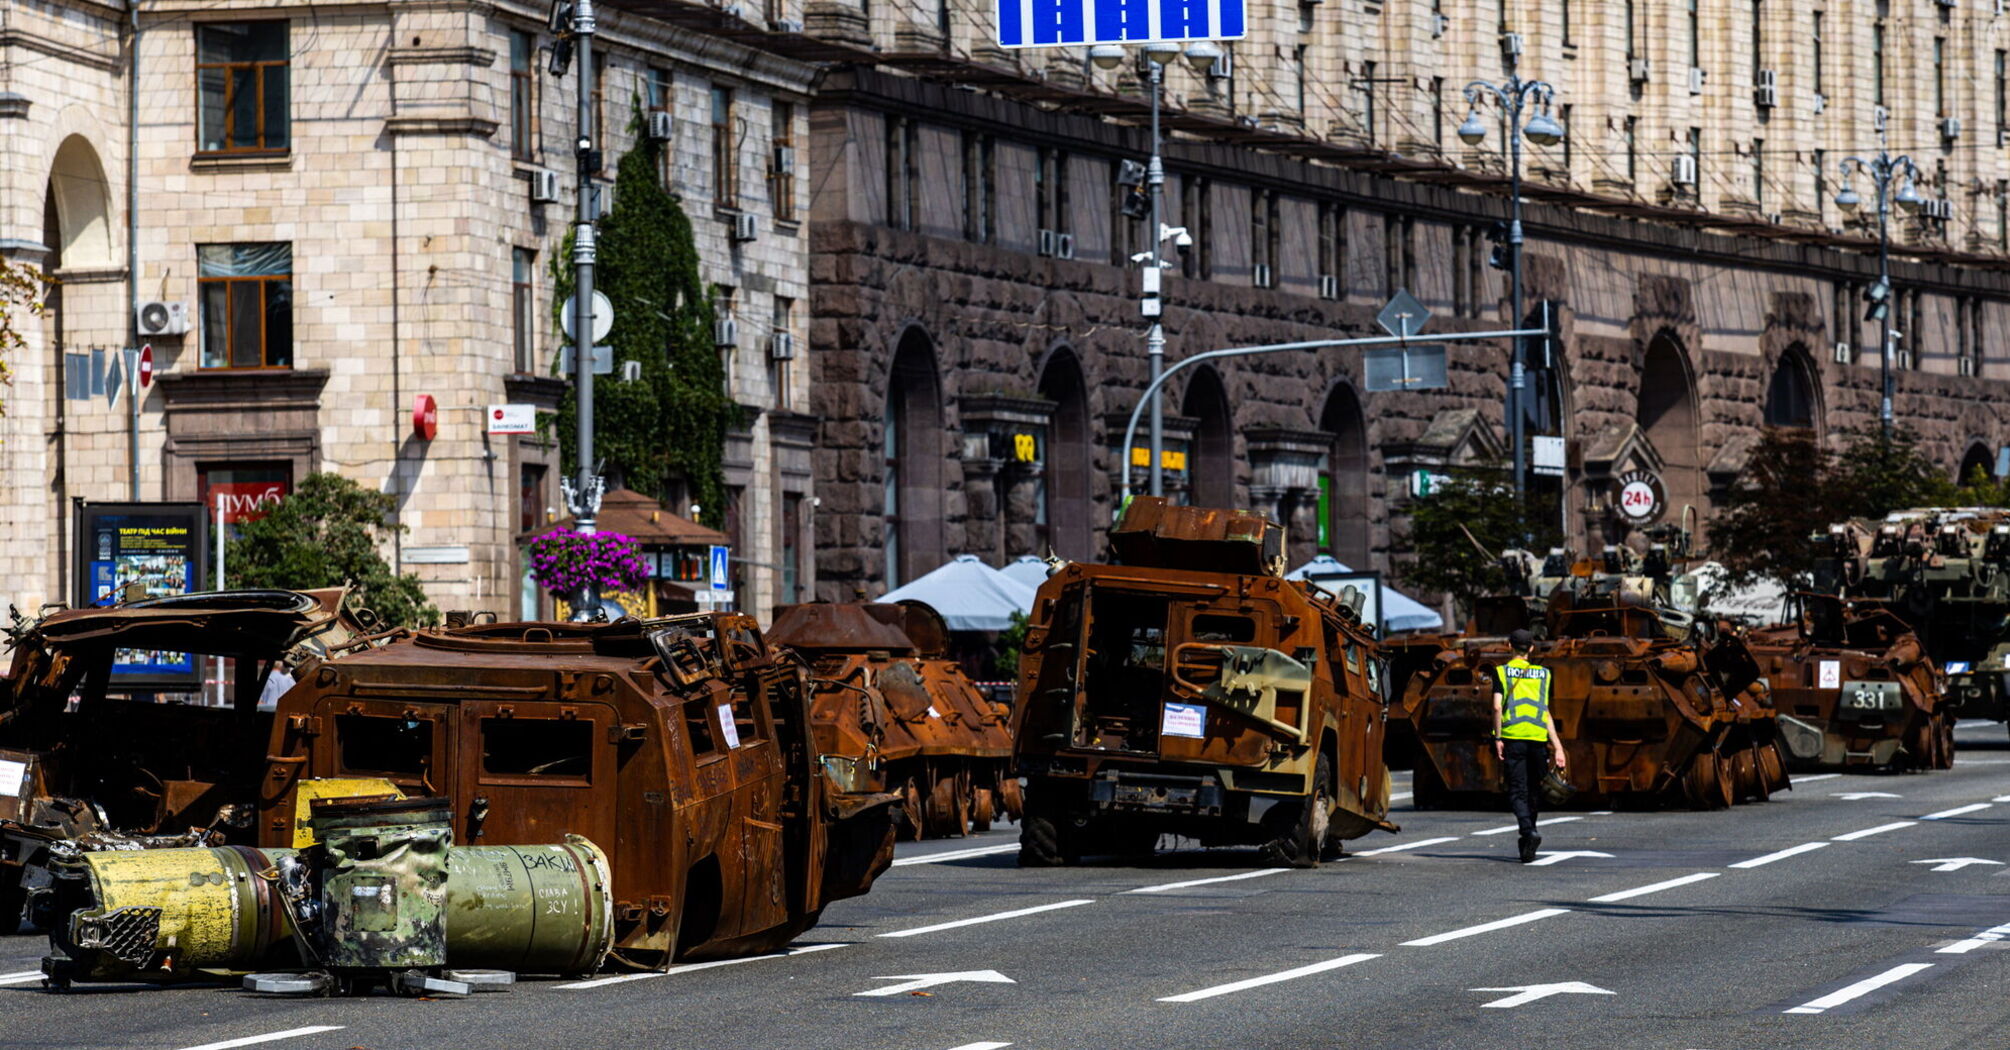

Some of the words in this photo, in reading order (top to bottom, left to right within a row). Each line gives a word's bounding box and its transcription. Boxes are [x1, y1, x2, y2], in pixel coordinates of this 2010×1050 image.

[138, 528, 151, 536] ПІД
[165, 526, 188, 535] ВІЙНИ
[1854, 690, 1885, 710] 331
[538, 887, 569, 899] СЛАВА
